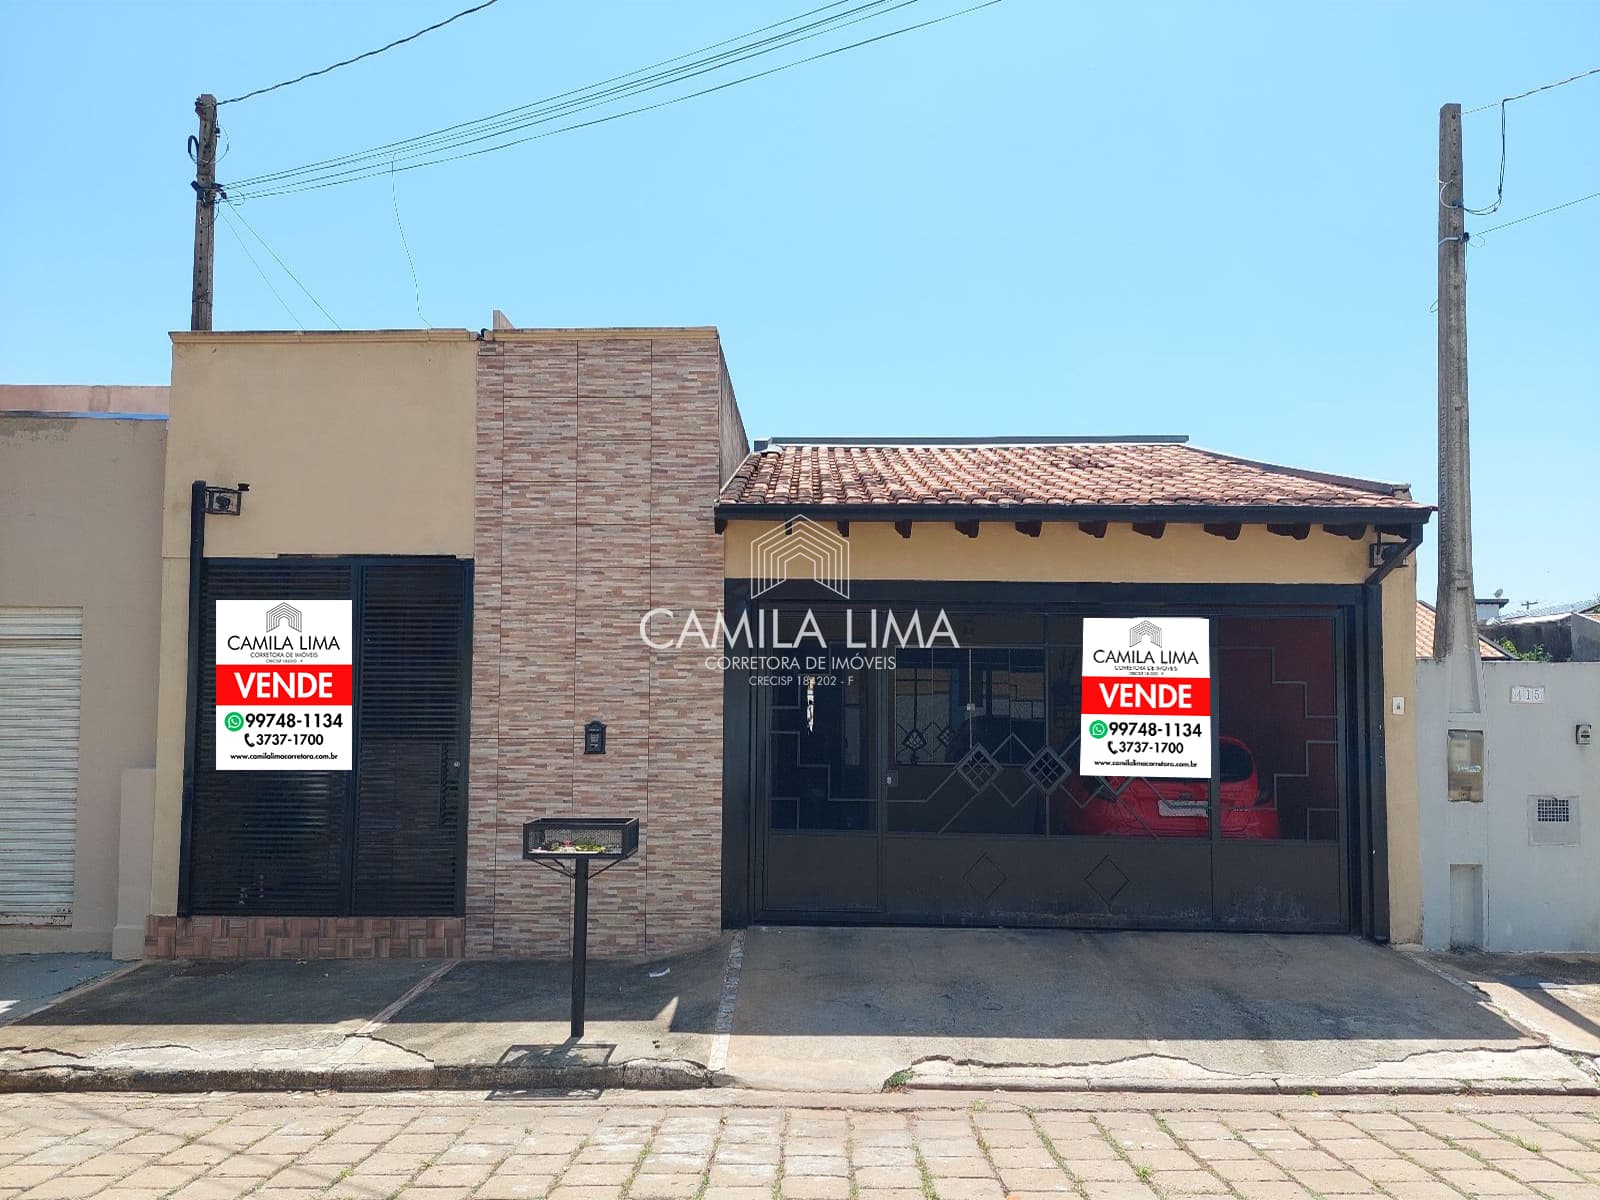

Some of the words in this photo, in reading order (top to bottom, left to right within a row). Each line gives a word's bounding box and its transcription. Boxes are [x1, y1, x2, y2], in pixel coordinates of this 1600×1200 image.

[227, 635, 294, 651] CAMILA
[299, 635, 341, 651] LIMA
[1093, 649, 1156, 664] CAMILA
[1160, 651, 1199, 665] LIMA
[234, 671, 333, 699] VENDE
[1099, 683, 1193, 708] VENDE
[245, 712, 344, 728] 99748-1134
[1109, 721, 1203, 738] 99748-1134
[256, 733, 324, 746] 3737-1700
[1118, 741, 1184, 754] 3737-1700
[230, 752, 338, 760] www.camilalimacorretora.com.br
